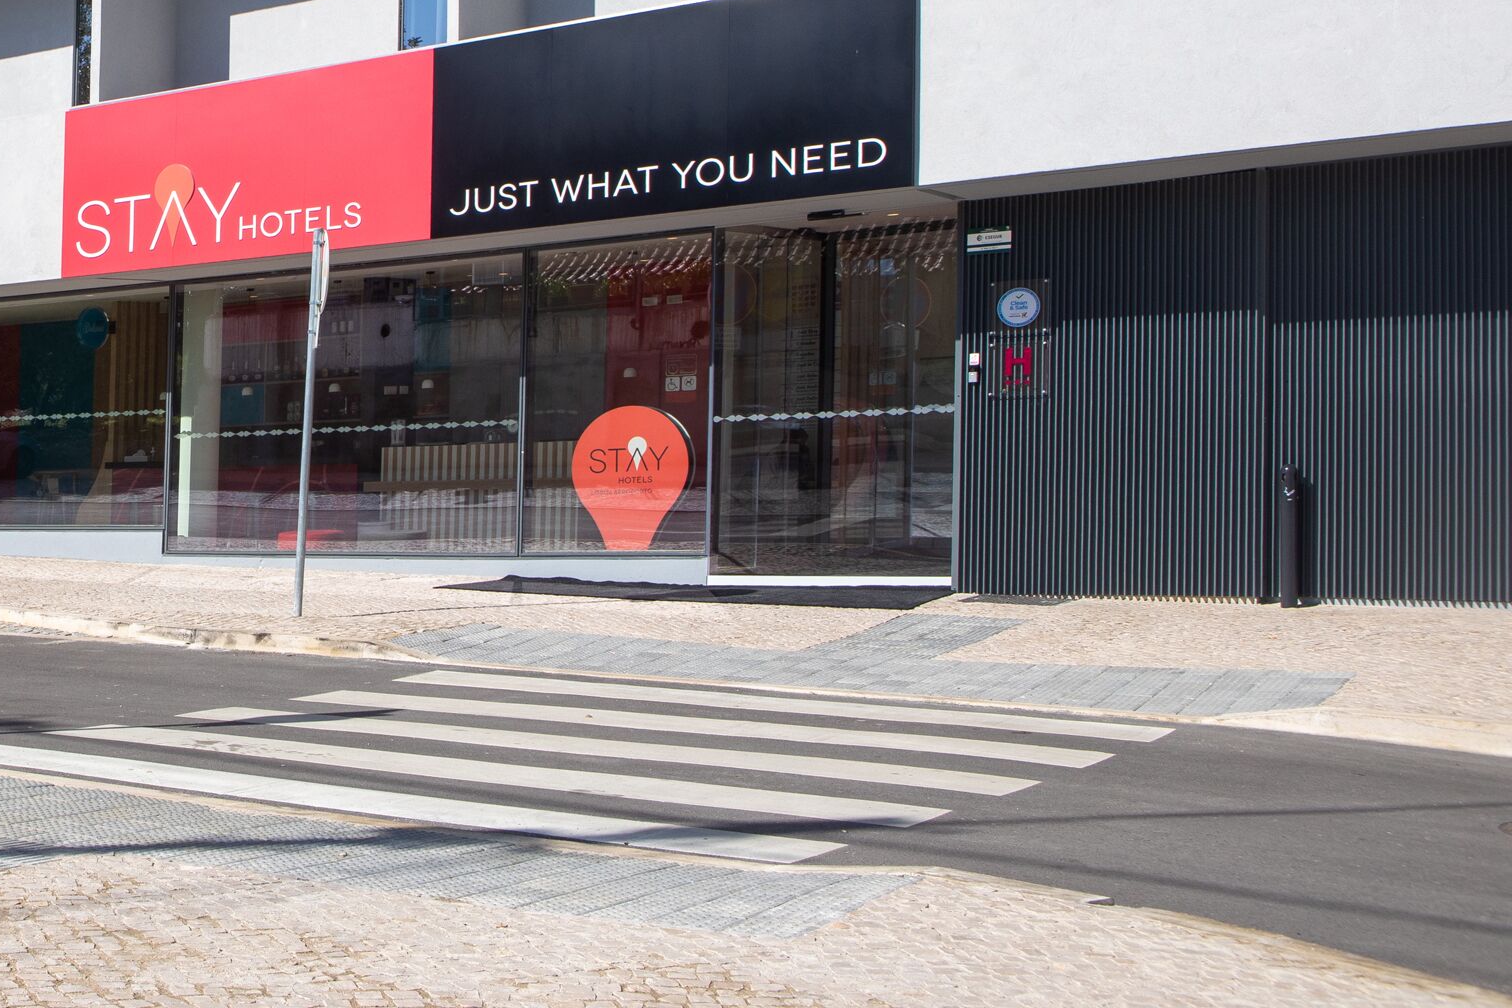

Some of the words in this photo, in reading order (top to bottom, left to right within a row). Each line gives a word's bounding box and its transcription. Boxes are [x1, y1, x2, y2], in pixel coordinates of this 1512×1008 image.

[448, 179, 540, 217] JUST
[550, 165, 659, 204] WHAT
[671, 152, 755, 189] YOU
[770, 136, 888, 179] NEED
[75, 181, 241, 259] STAY
[238, 201, 363, 241] HOTELS
[589, 445, 669, 474] STAY
[618, 475, 653, 485] HOTELS
